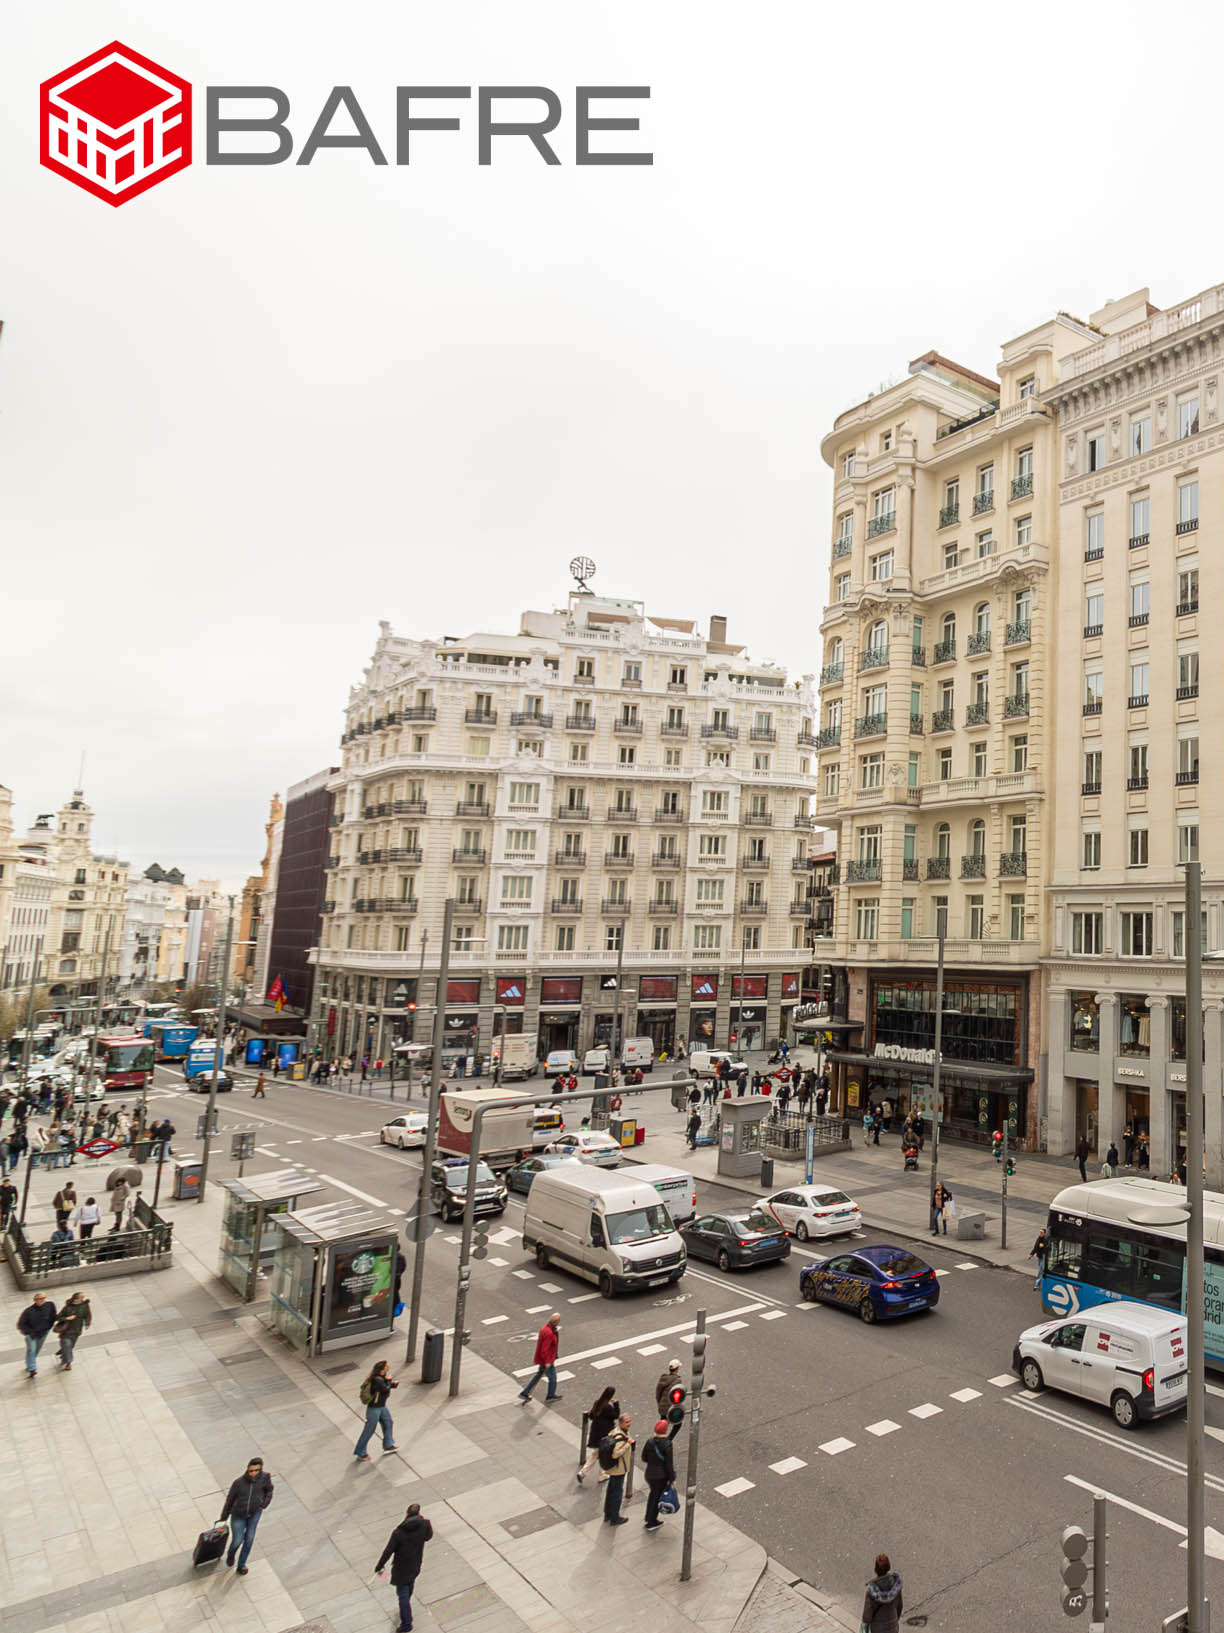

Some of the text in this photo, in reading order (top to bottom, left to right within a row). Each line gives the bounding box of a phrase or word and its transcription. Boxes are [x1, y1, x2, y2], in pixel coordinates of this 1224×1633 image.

[874, 1043, 943, 1064] McDonalds
[1118, 1067, 1145, 1077] BERSHKA
[1171, 1073, 1187, 1082] BERS
[1203, 1280, 1220, 1297] tos
